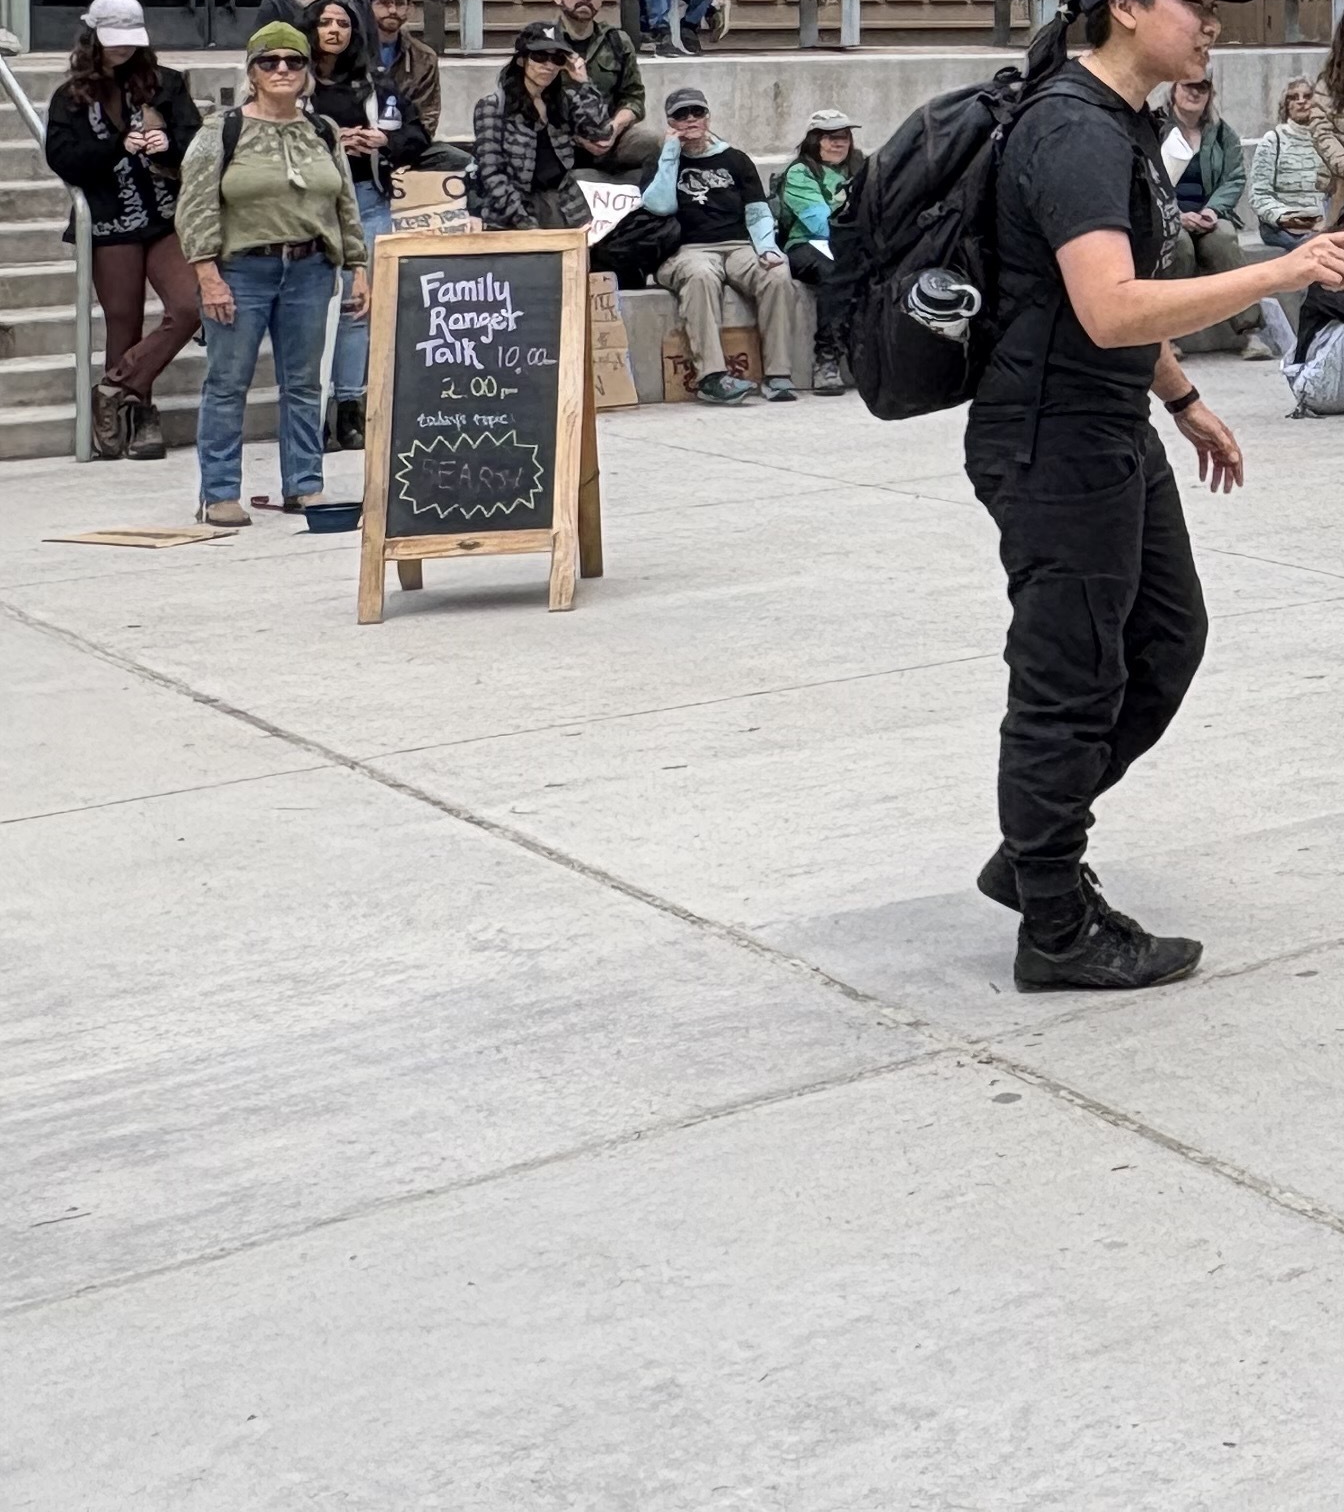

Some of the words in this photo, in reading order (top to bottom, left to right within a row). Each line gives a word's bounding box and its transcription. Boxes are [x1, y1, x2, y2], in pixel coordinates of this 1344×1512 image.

[593, 190, 641, 211] NOT
[420, 271, 512, 313] Family
[429, 307, 524, 344] Ranger
[416, 338, 484, 370] Talk
